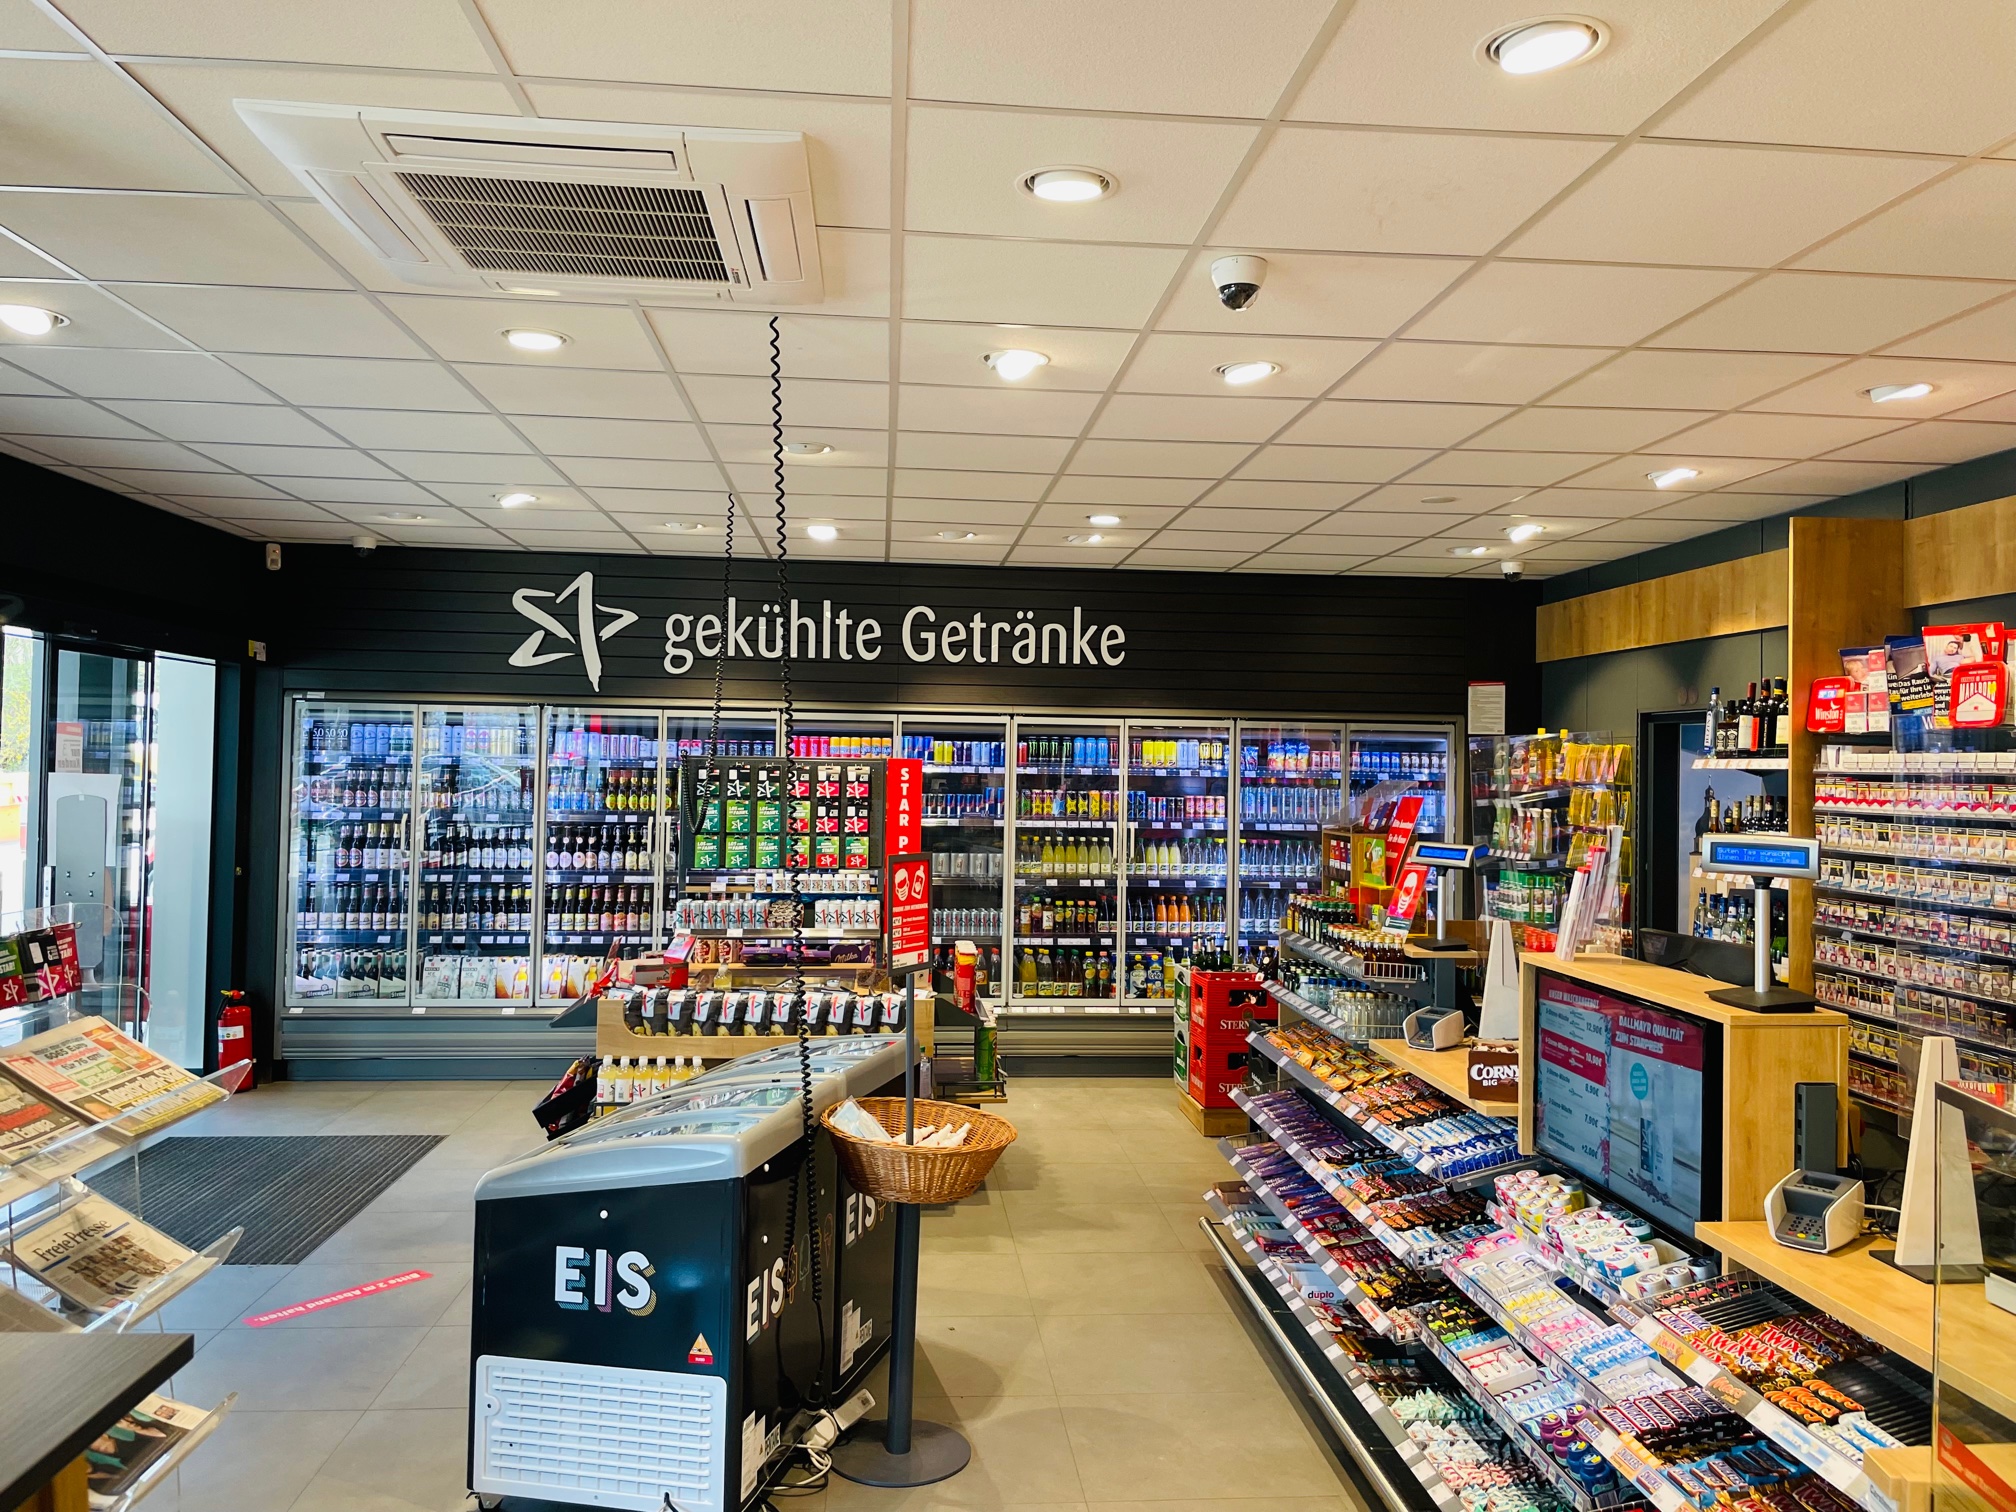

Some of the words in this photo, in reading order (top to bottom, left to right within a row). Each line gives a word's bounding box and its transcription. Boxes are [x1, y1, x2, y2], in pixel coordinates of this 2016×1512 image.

[665, 597, 881, 674] gekühlte
[902, 605, 1125, 666] Getränke
[1815, 707, 1839, 720] Winston
[899, 768, 910, 826] STAR
[1616, 1031, 1629, 1044] ZUM
[1619, 1015, 1651, 1034] DALLMAYR
[1652, 1024, 1684, 1042] QUALITÄT
[1482, 1079, 1498, 1087] BIG
[32, 1237, 70, 1262] Freie
[66, 1219, 112, 1246] Presse
[388, 1273, 420, 1285] Bitte
[555, 1246, 655, 1312] EIS
[307, 1289, 361, 1309] Abstand
[747, 1257, 784, 1341] EIS
[1307, 1290, 1334, 1300] duplo
[1760, 1324, 1808, 1354] TWIX
